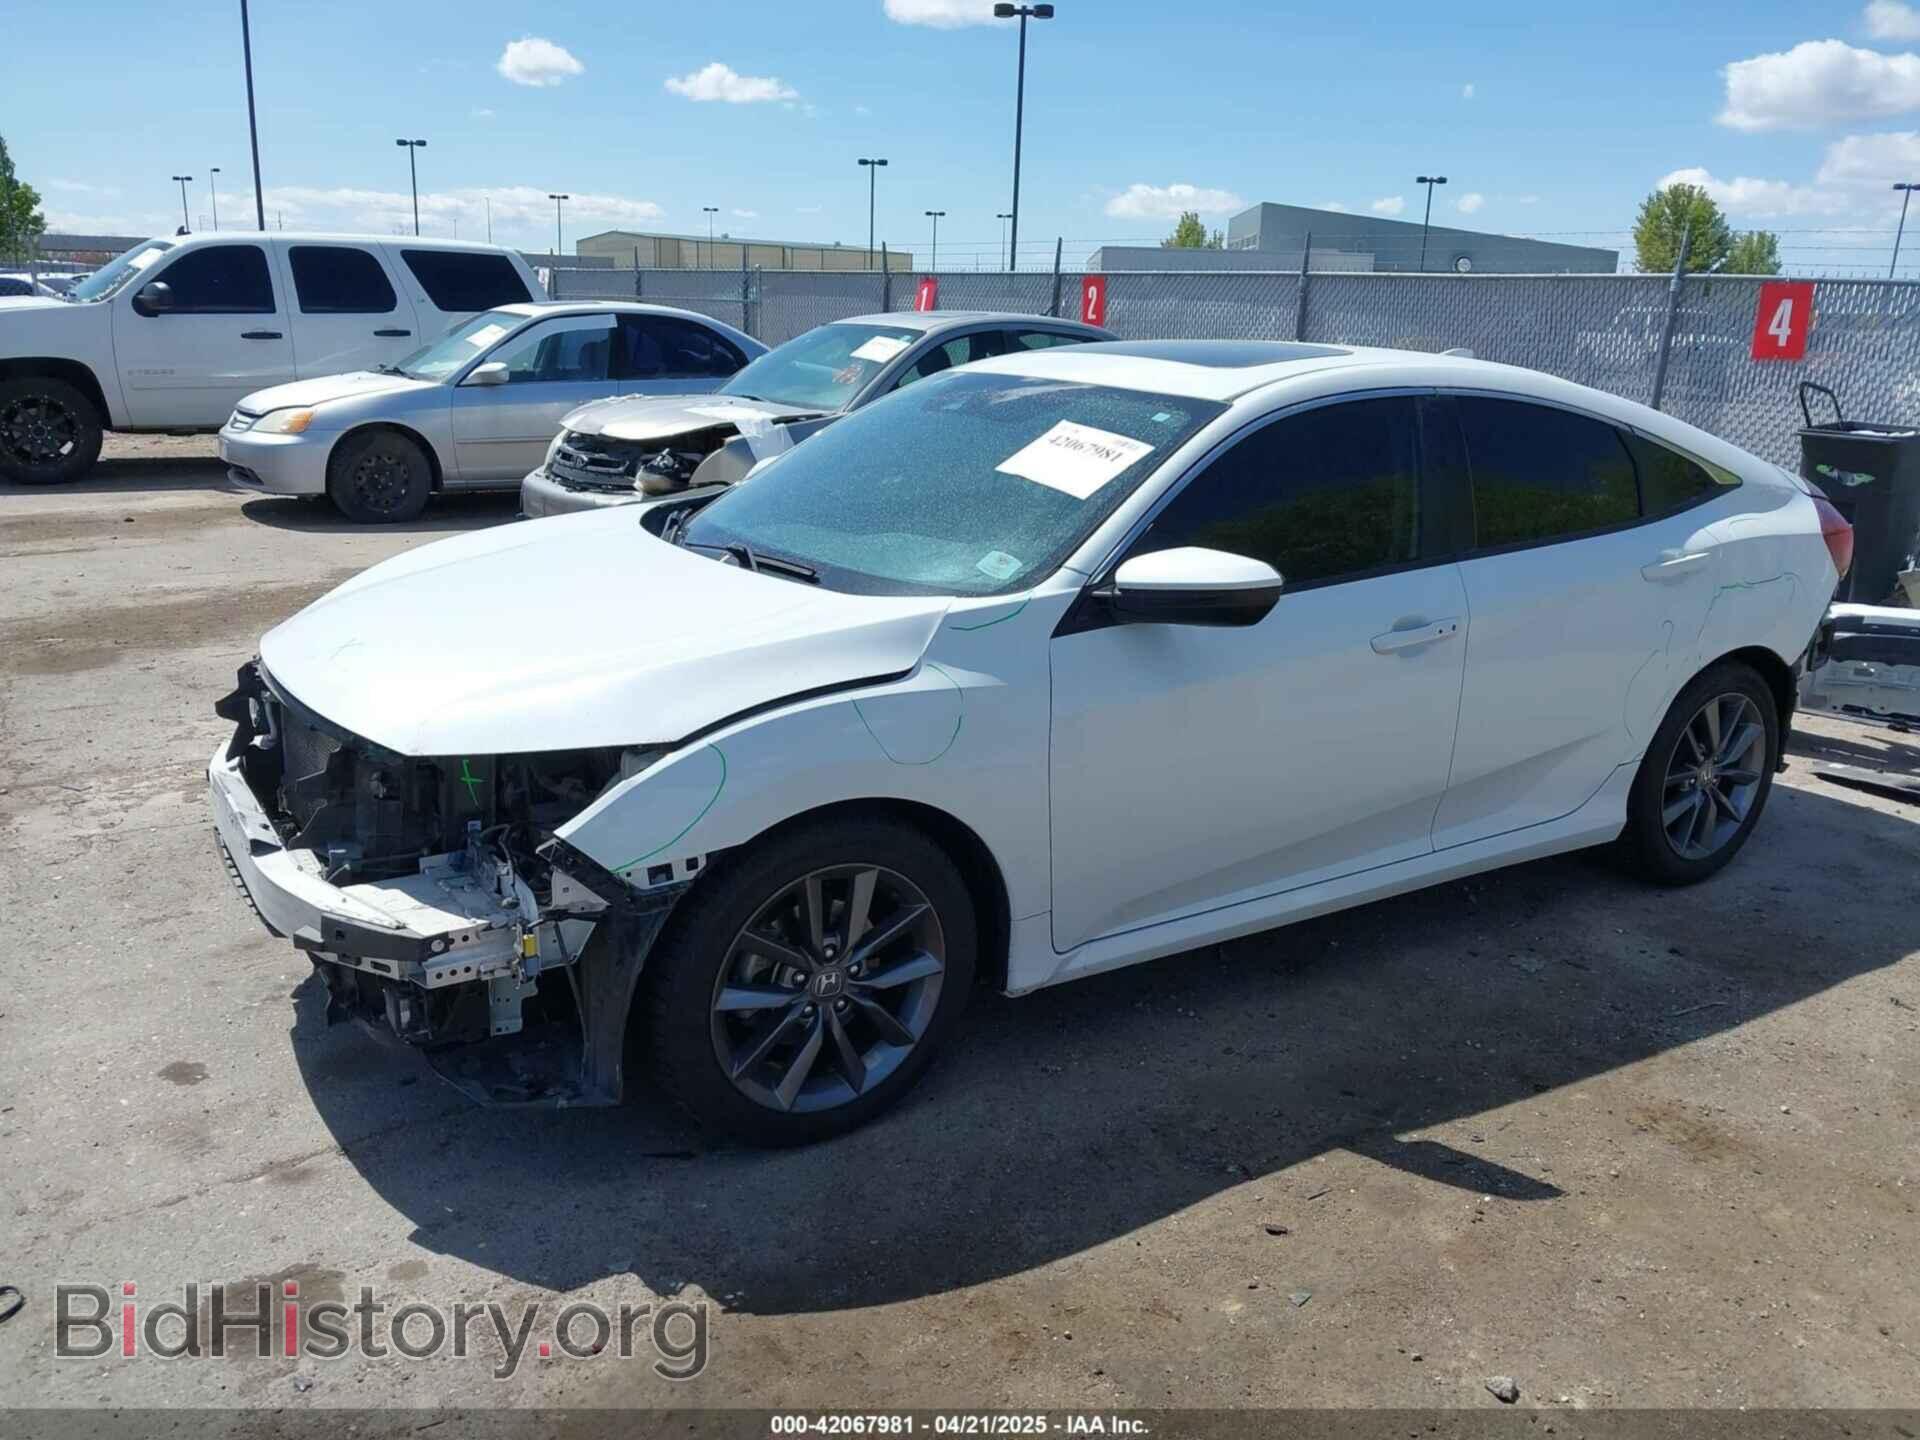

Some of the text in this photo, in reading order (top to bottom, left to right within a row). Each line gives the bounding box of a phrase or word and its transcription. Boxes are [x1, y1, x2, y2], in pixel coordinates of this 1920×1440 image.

[919, 286, 929, 313] 1
[1086, 285, 1098, 320] 2
[1767, 298, 1794, 347] 4
